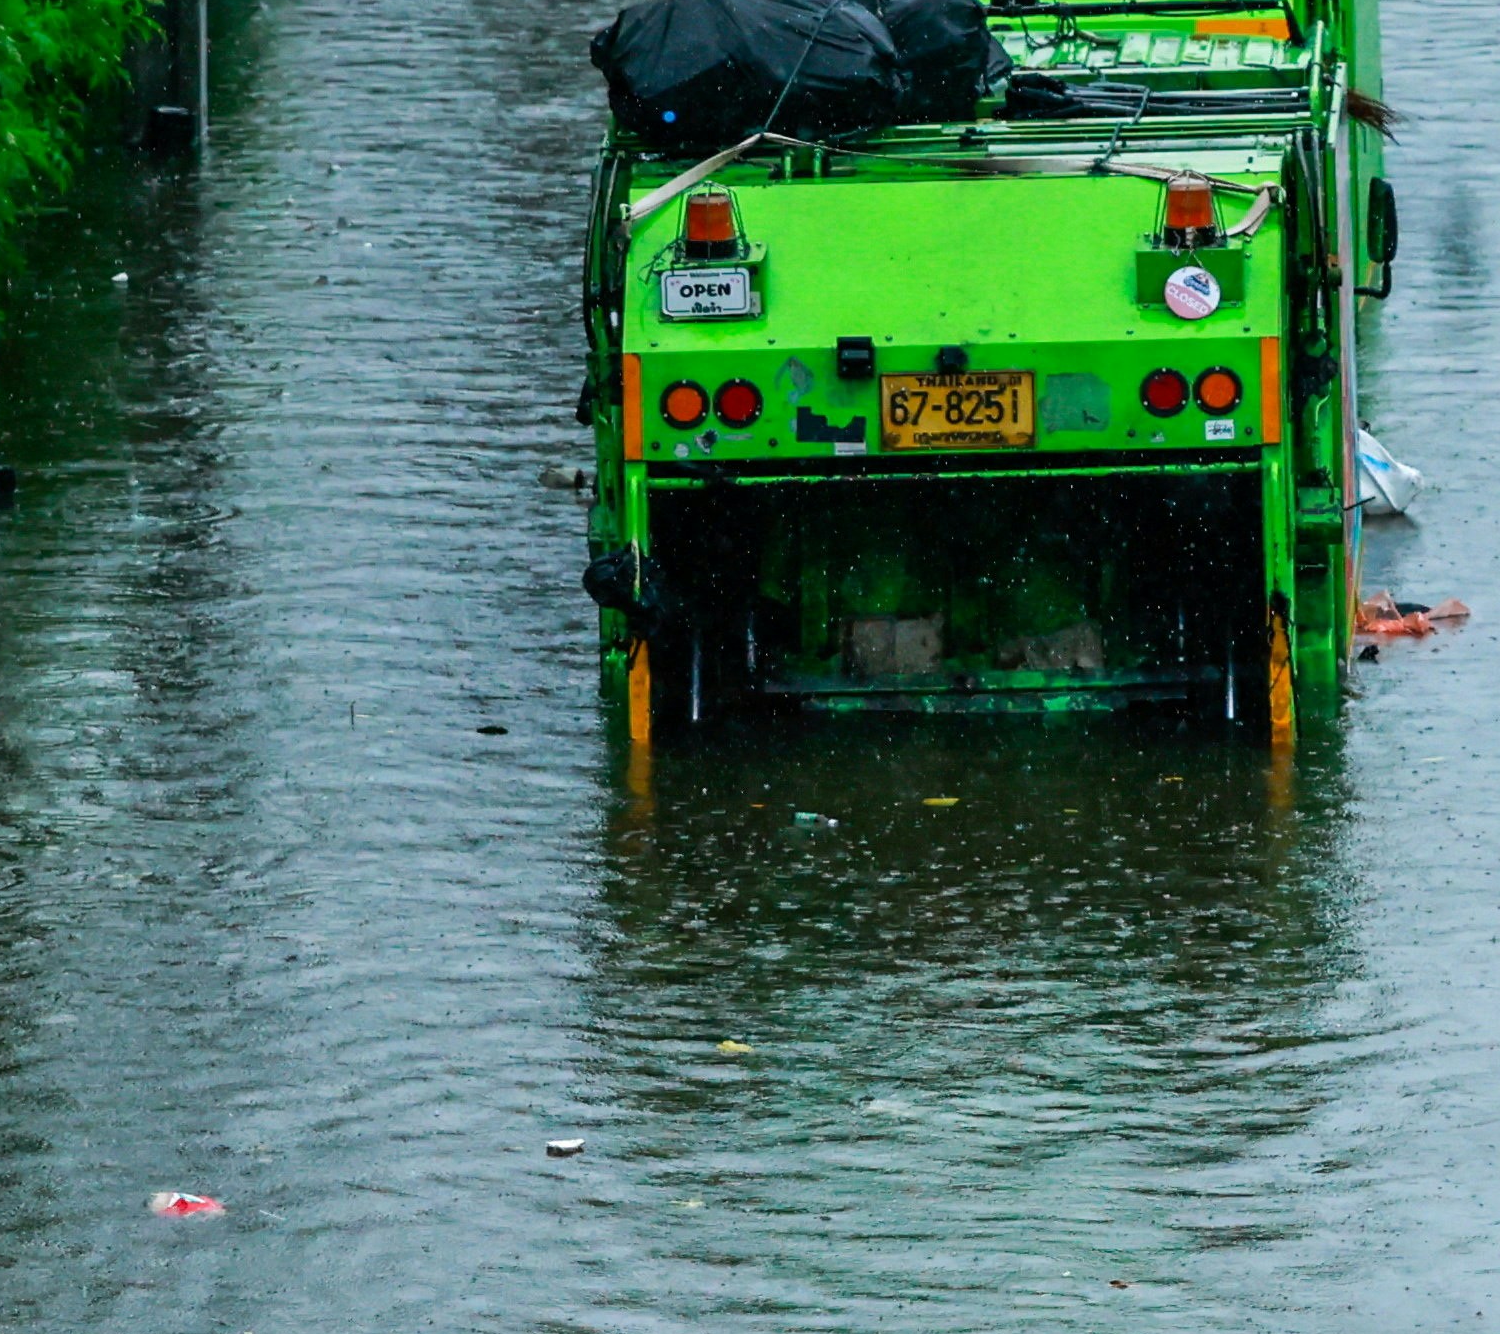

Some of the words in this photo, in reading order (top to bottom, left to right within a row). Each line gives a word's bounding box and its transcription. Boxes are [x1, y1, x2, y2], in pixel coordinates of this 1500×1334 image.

[679, 283, 732, 298] OPEN
[1167, 285, 1209, 315] CLOSED
[915, 375, 999, 388] THAILAND
[890, 389, 1019, 426] 67-8251
